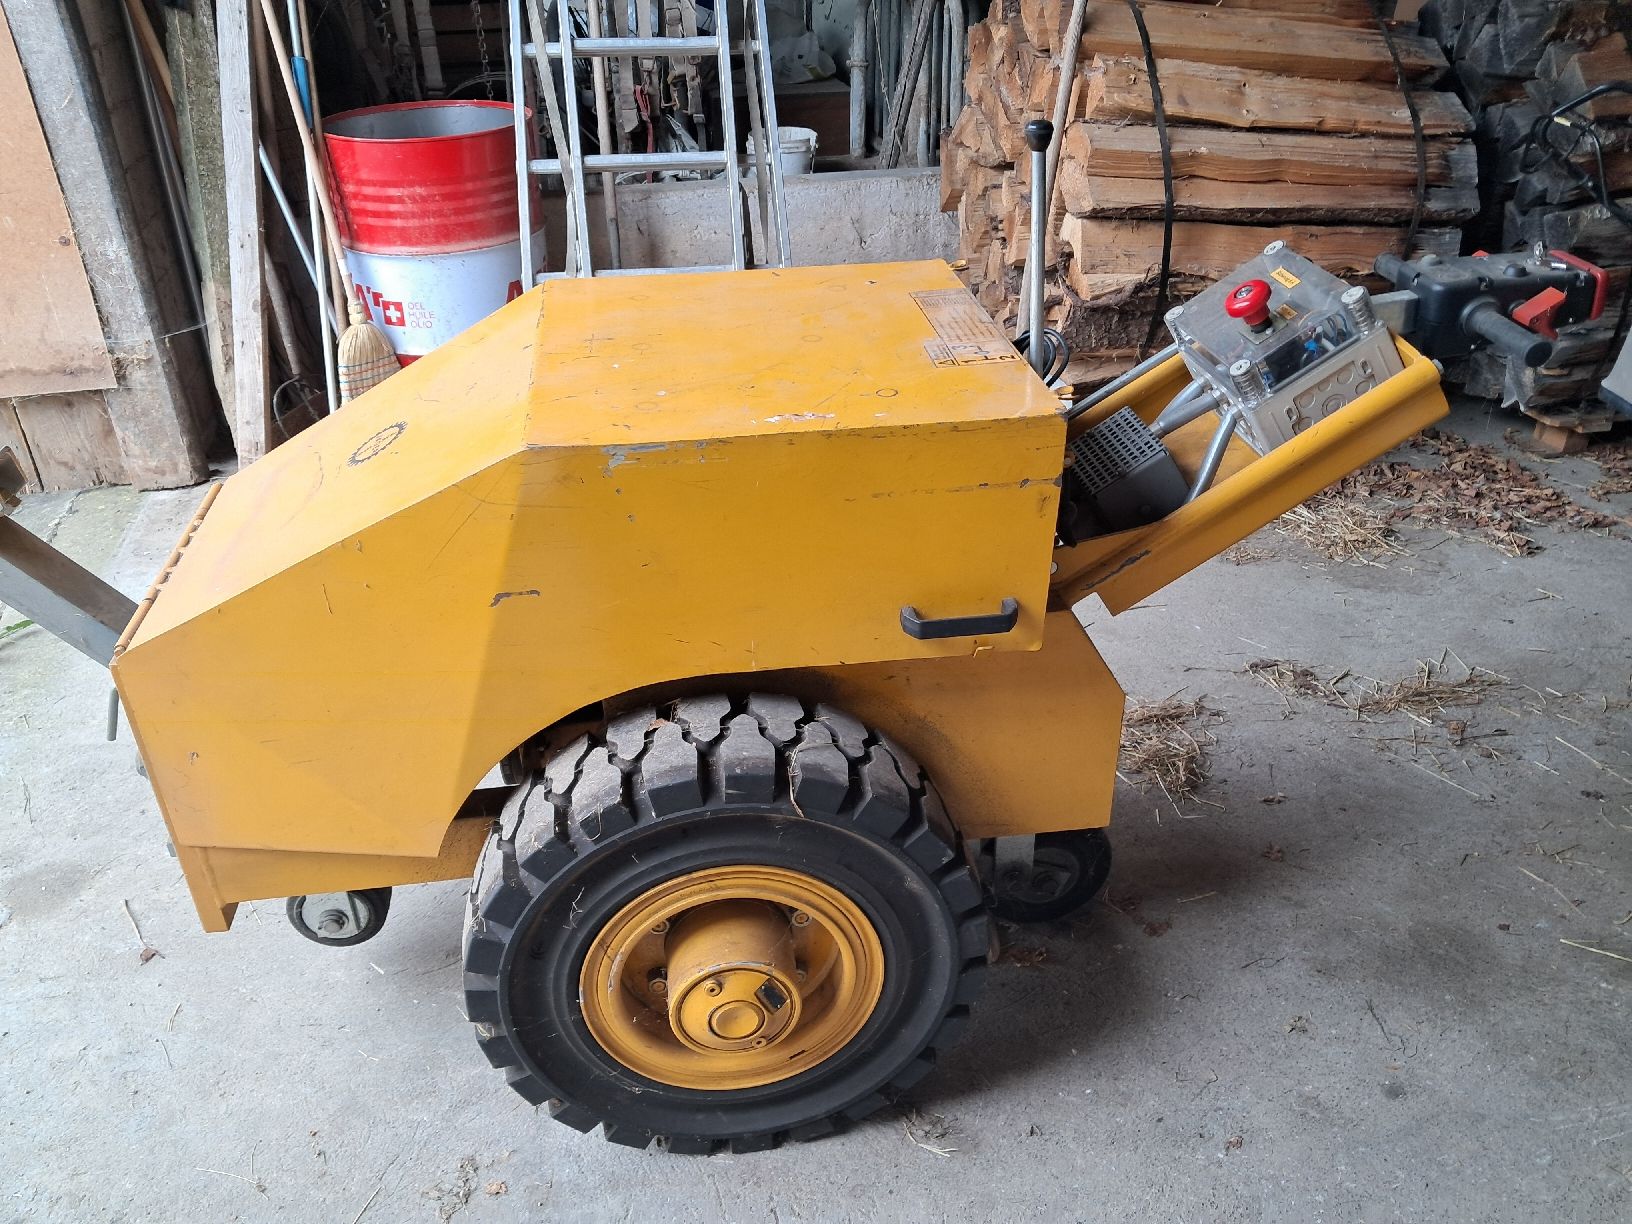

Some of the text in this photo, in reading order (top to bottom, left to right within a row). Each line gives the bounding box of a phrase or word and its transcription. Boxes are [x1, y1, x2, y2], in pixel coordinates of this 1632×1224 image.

[407, 301, 425, 310] OEL
[408, 310, 436, 319] HUILE
[410, 319, 432, 328] OLIO
